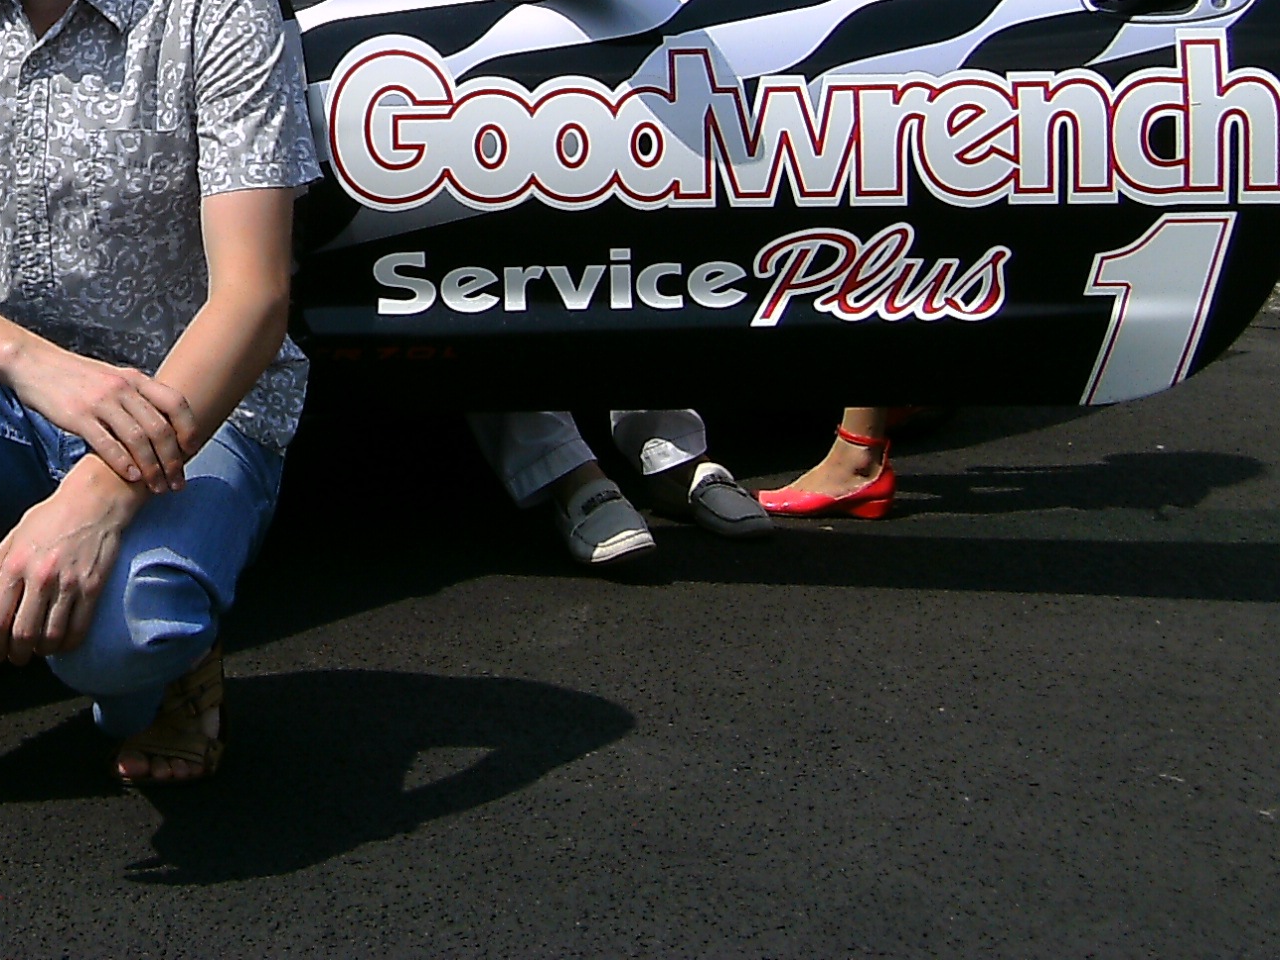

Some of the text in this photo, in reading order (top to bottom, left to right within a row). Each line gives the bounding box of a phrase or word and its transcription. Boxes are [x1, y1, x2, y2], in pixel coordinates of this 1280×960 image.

[326, 27, 1280, 212] Goodwrench
[372, 221, 1013, 328] Service Plus
[1078, 210, 1239, 407] 1
